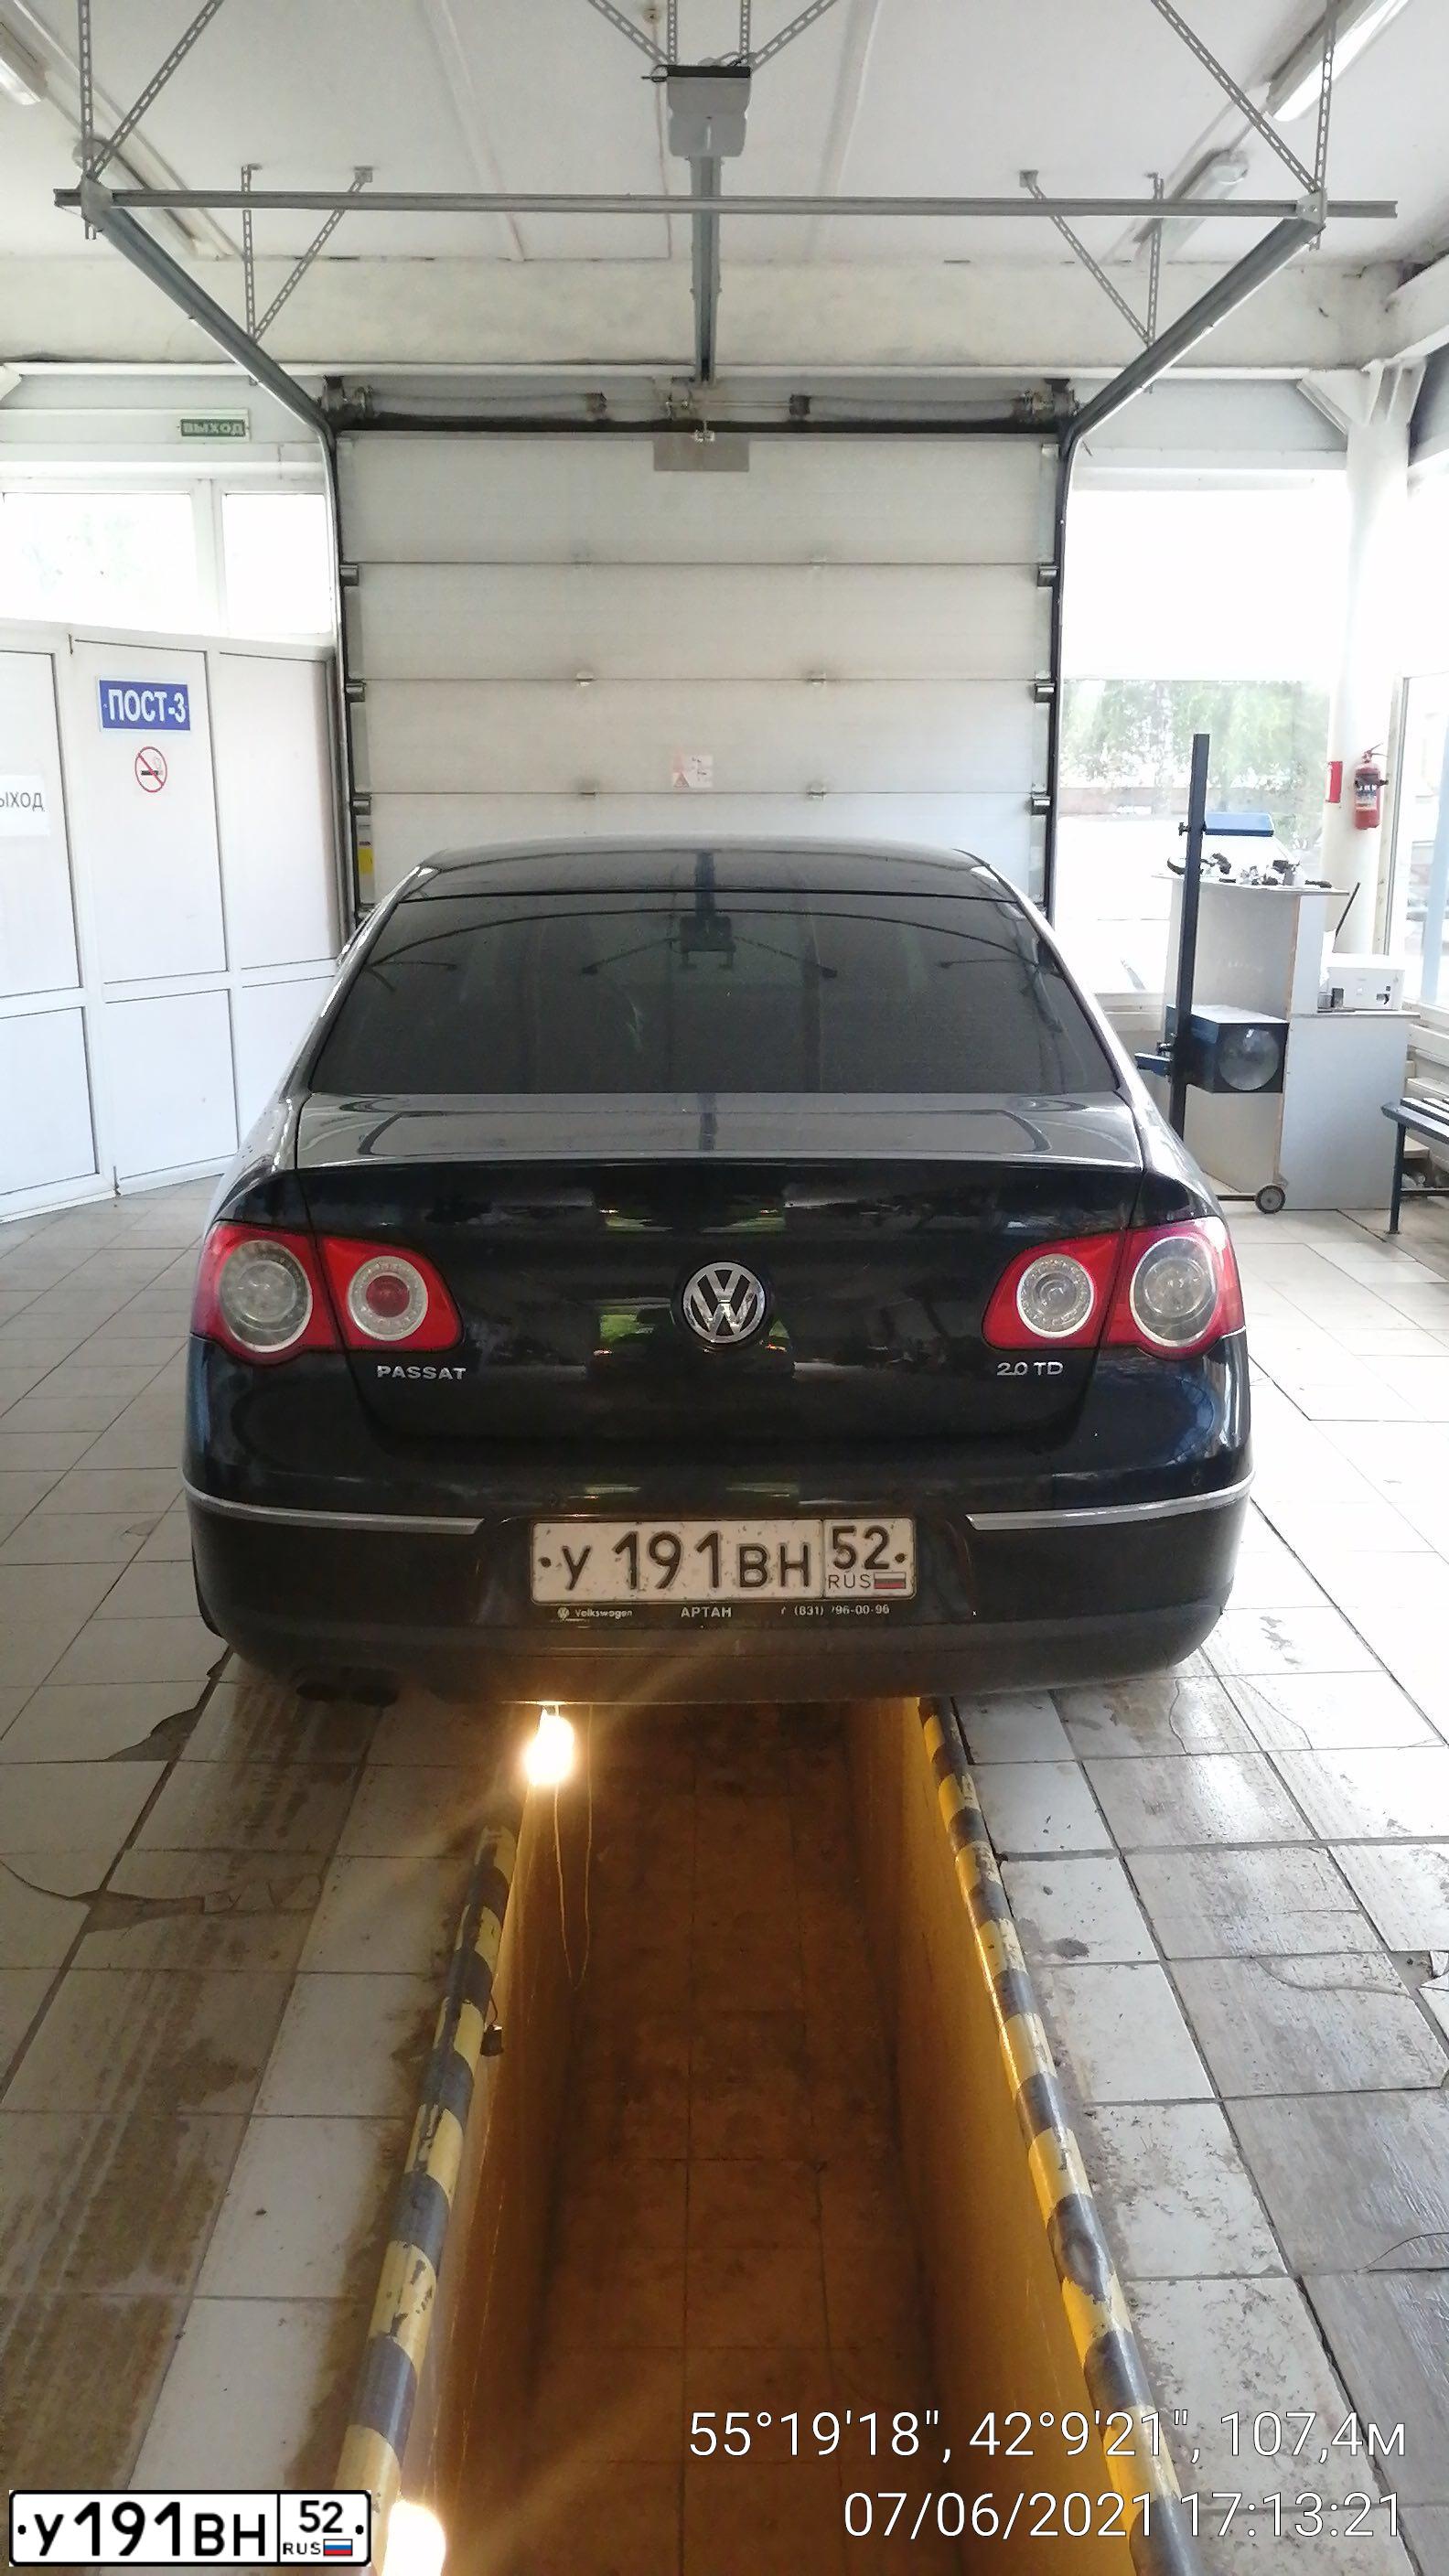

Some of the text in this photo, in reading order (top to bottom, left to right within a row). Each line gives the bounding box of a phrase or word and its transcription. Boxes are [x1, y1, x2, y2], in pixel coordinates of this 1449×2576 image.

[108, 688, 187, 723] ПОСТ-3
[377, 1365, 467, 1379] PASSAT
[1034, 1361, 1064, 1376] TD
[832, 1525, 890, 1571] 52
[827, 1572, 872, 1590] RUS
[574, 1608, 633, 1619] Volkswagen
